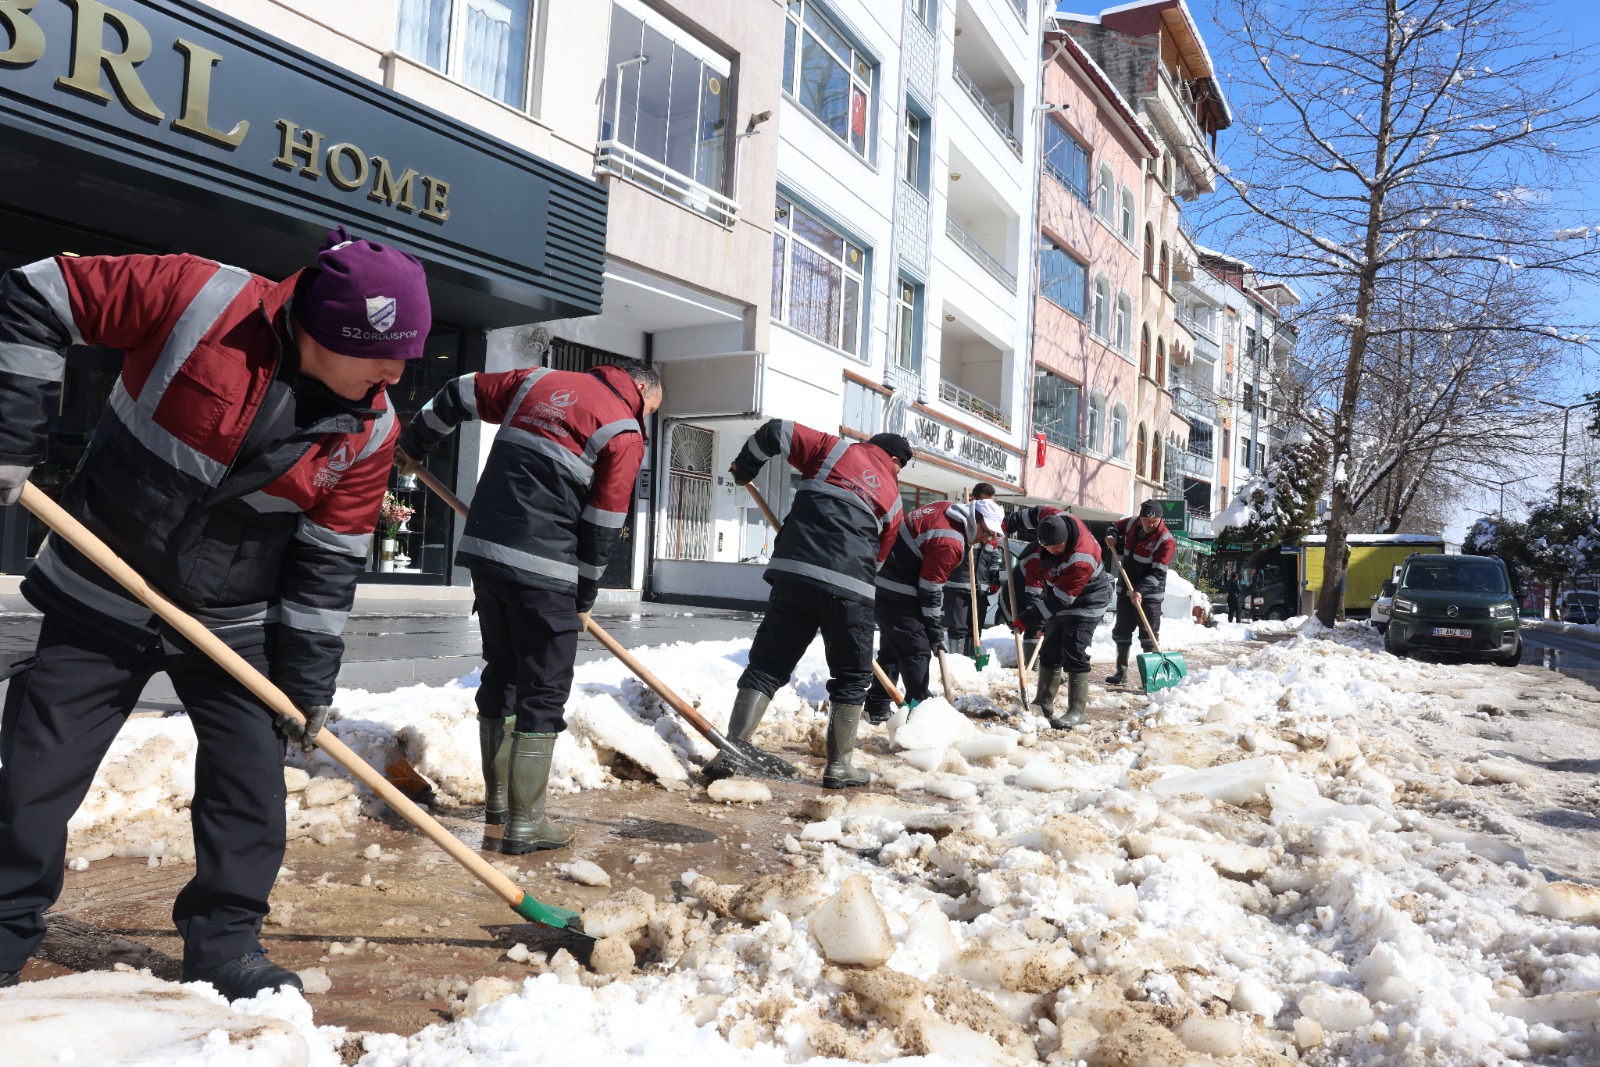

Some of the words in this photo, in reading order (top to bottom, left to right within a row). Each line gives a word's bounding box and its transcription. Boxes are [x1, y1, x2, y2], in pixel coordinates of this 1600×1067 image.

[272, 118, 451, 224] HOME
[915, 417, 941, 445] YAPI
[944, 428, 955, 452] &
